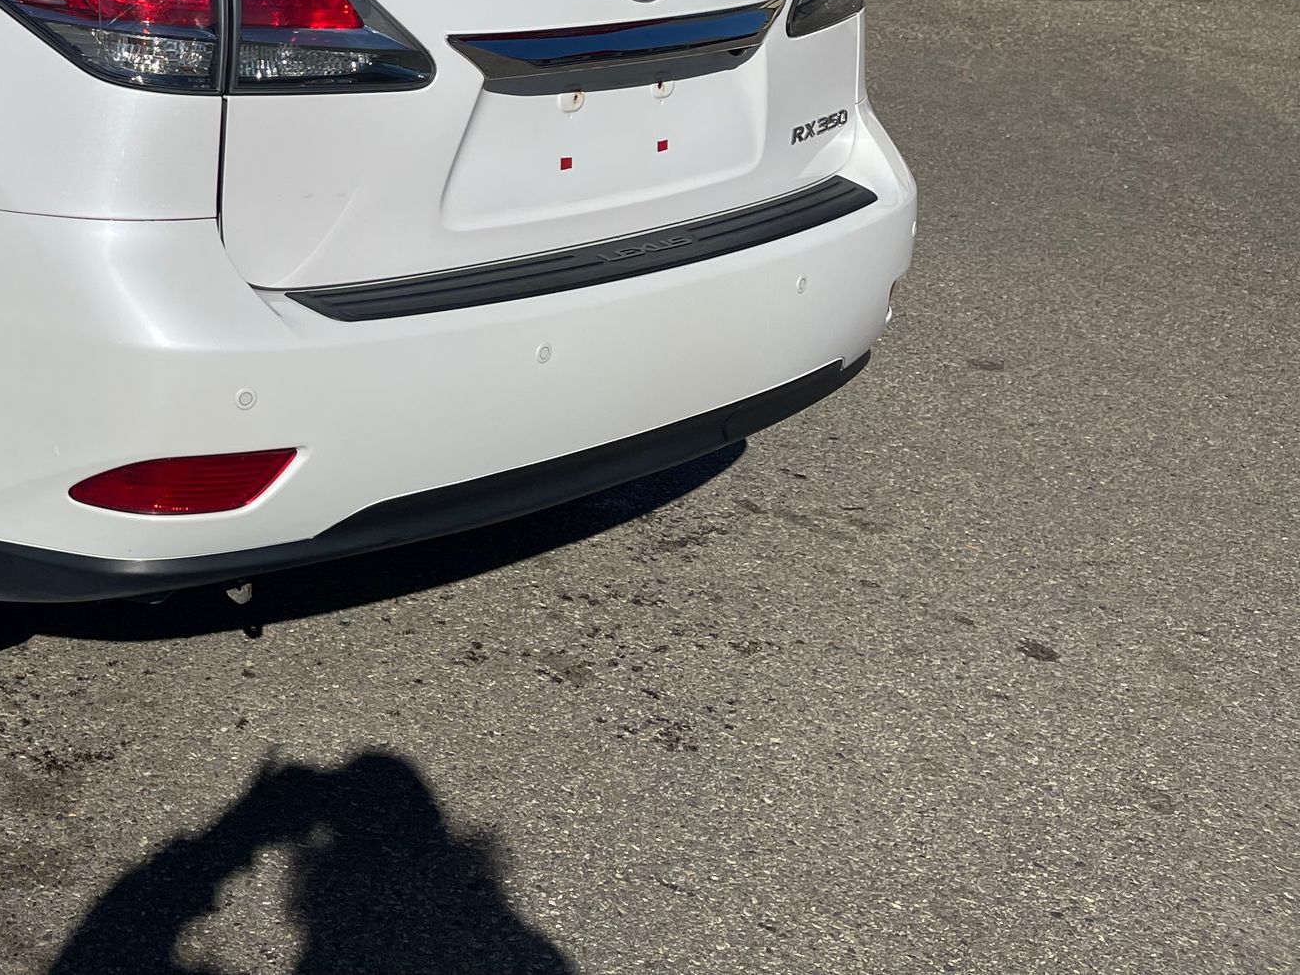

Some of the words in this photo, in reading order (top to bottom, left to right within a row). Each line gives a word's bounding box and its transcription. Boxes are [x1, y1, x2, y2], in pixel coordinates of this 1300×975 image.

[791, 120, 817, 146] RX
[816, 109, 848, 135] 350
[597, 236, 693, 263] LEXUS
